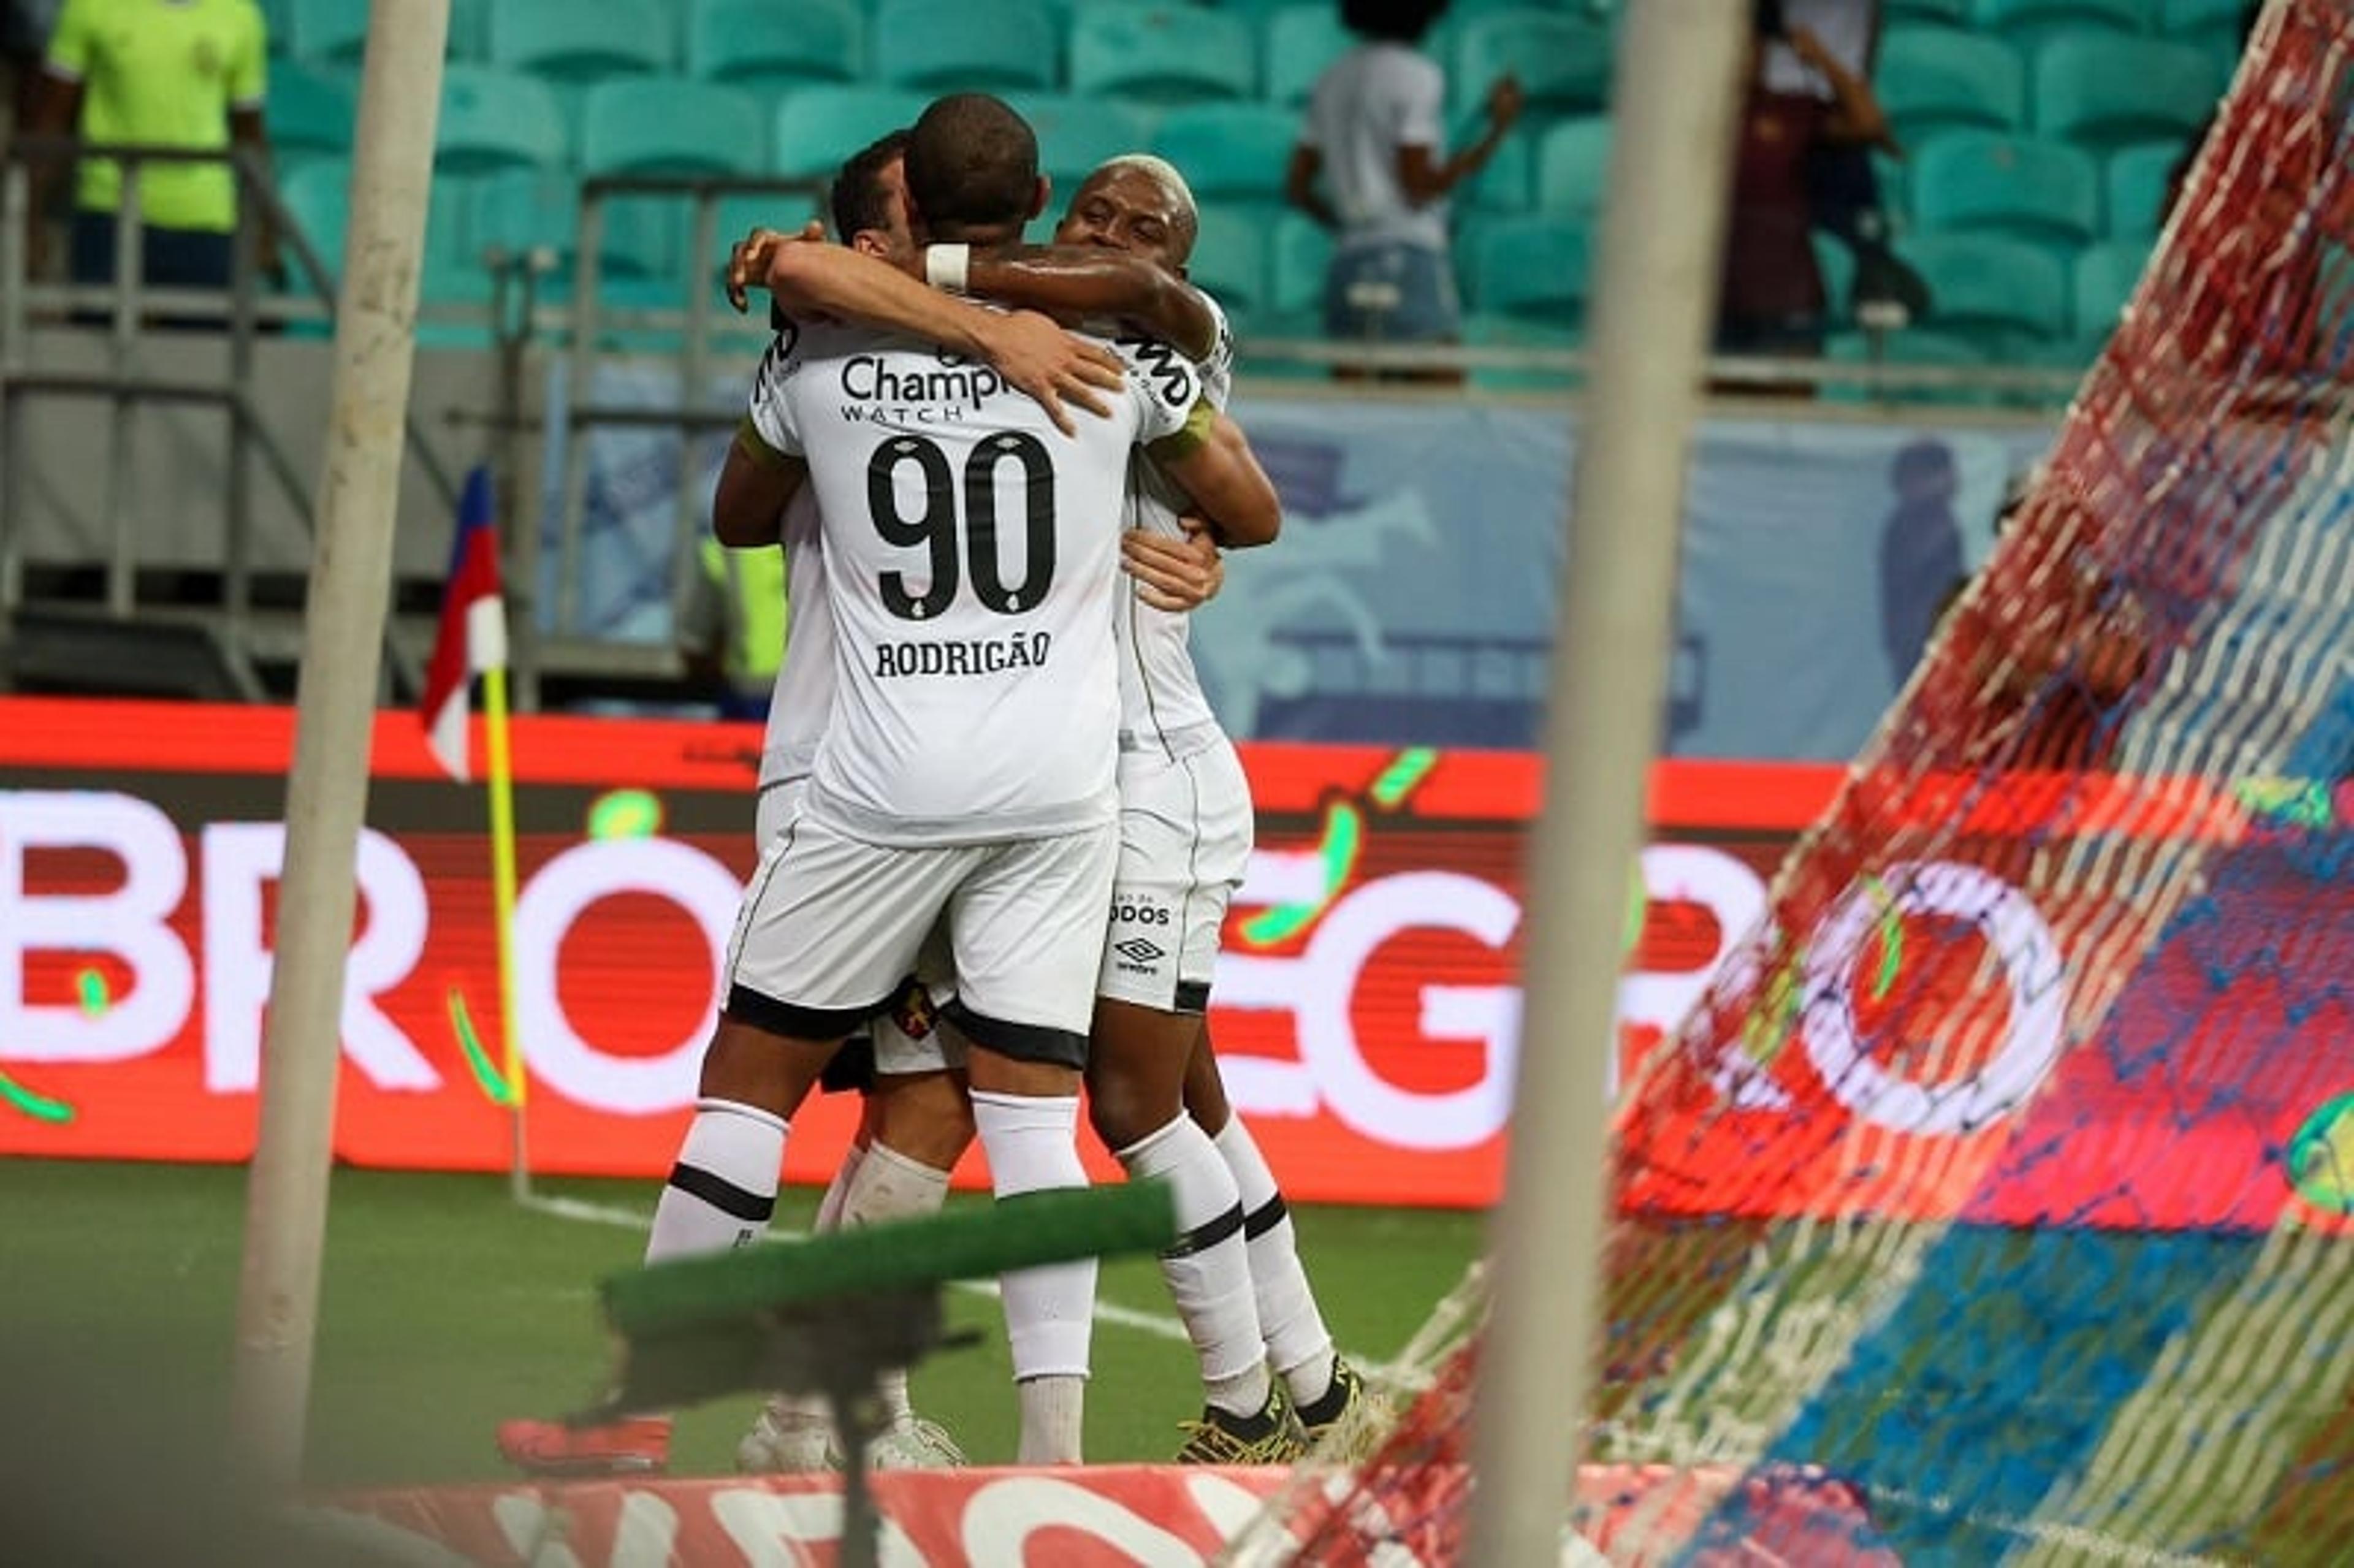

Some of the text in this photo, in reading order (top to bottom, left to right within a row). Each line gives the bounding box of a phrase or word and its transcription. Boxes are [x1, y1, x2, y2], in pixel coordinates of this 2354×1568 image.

[840, 406, 963, 422] WATCH
[867, 431, 1056, 621] 90
[875, 632, 1051, 677] RODRIGÃO
